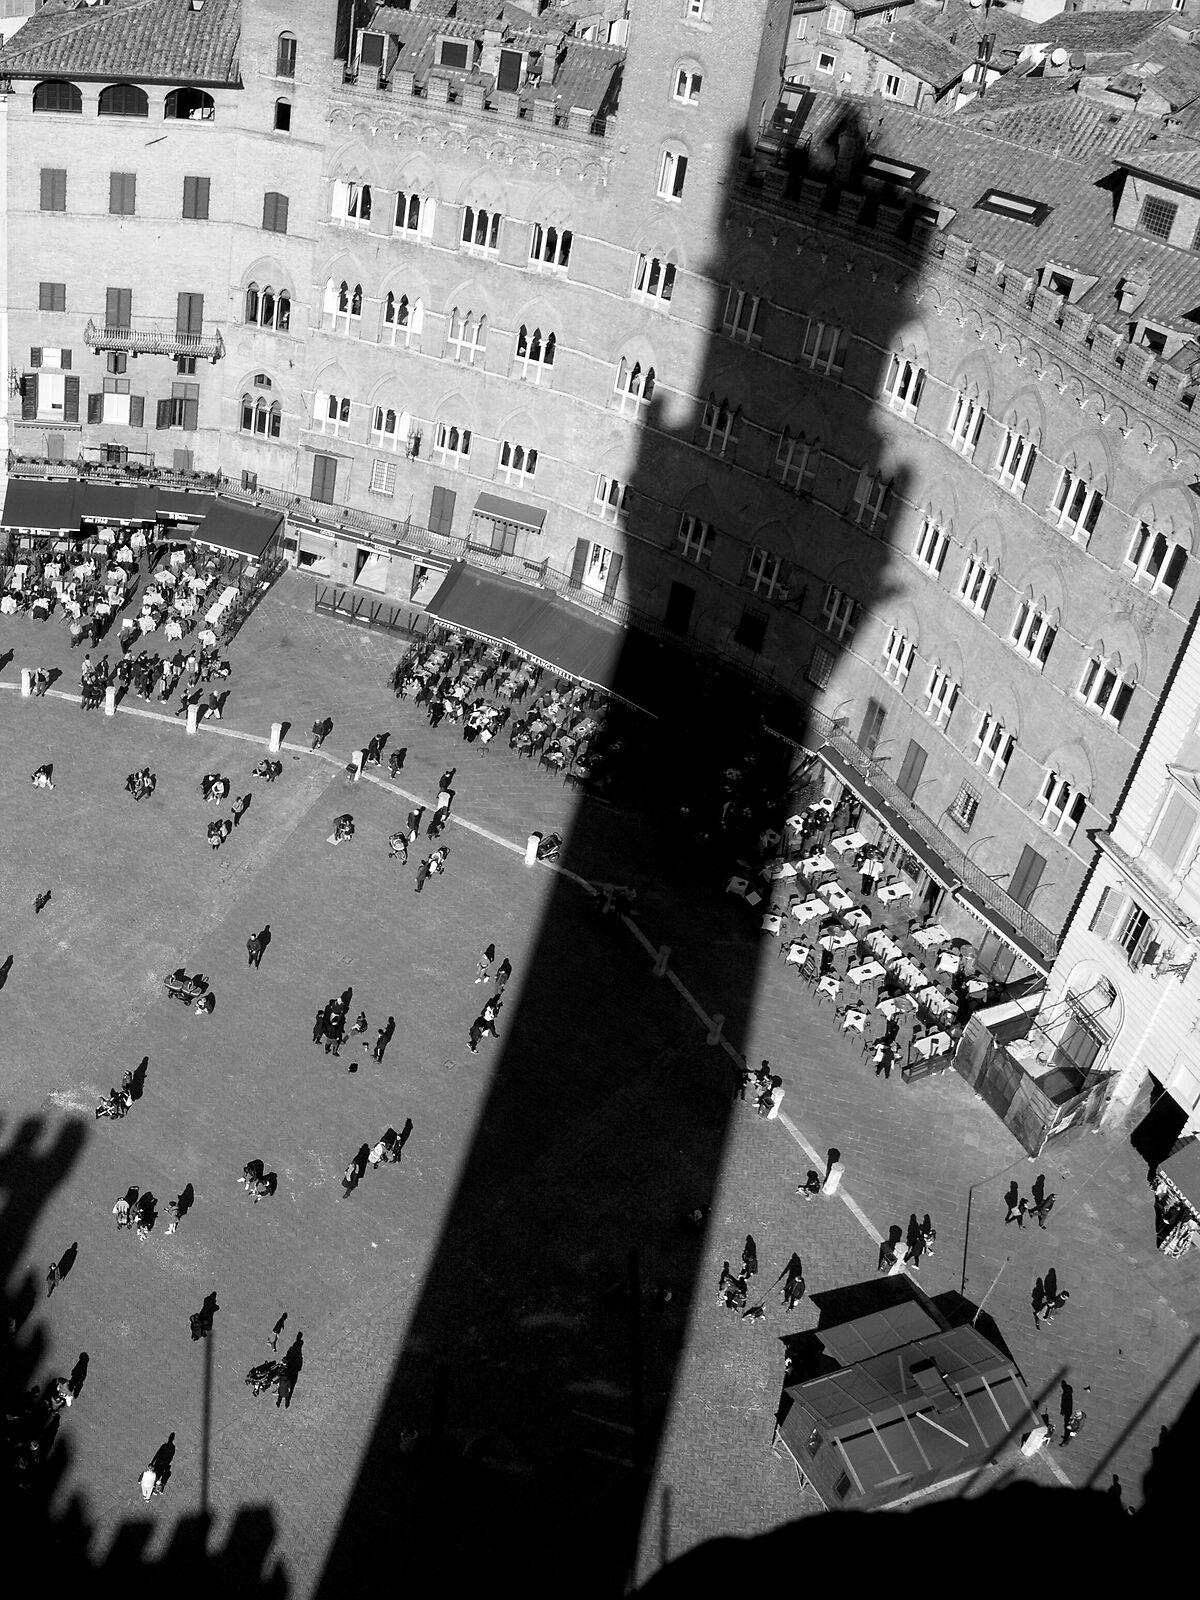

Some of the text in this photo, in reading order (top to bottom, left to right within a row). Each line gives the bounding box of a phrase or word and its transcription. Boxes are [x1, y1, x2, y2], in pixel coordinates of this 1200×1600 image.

[433, 619, 503, 647] PIZZERIA RISTORANTE
[514, 648, 574, 681] BAR MANGANELLI
